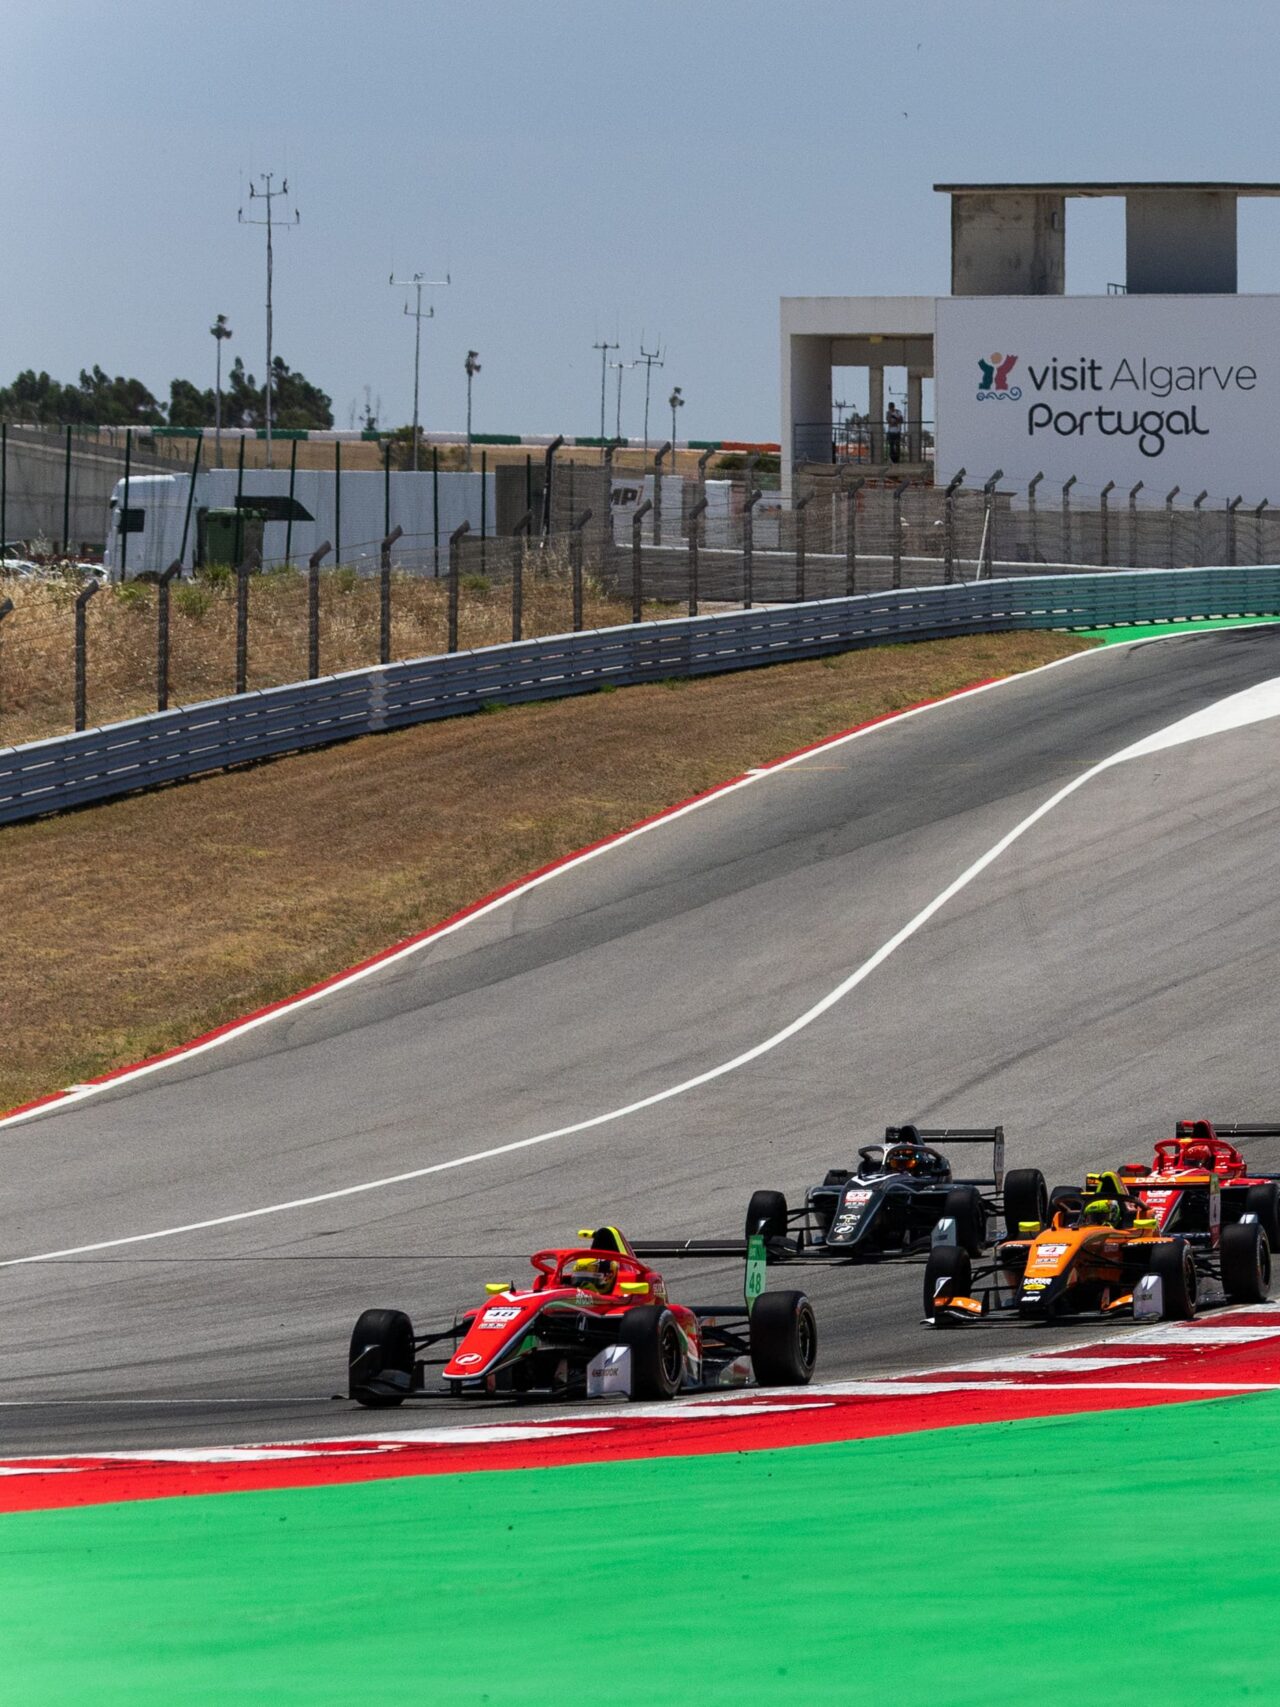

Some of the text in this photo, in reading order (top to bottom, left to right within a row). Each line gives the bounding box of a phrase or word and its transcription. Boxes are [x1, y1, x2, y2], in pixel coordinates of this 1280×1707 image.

[1028, 357, 1257, 397] visit Algarve
[1028, 403, 1210, 457] Portugal
[748, 1271, 762, 1294] 48
